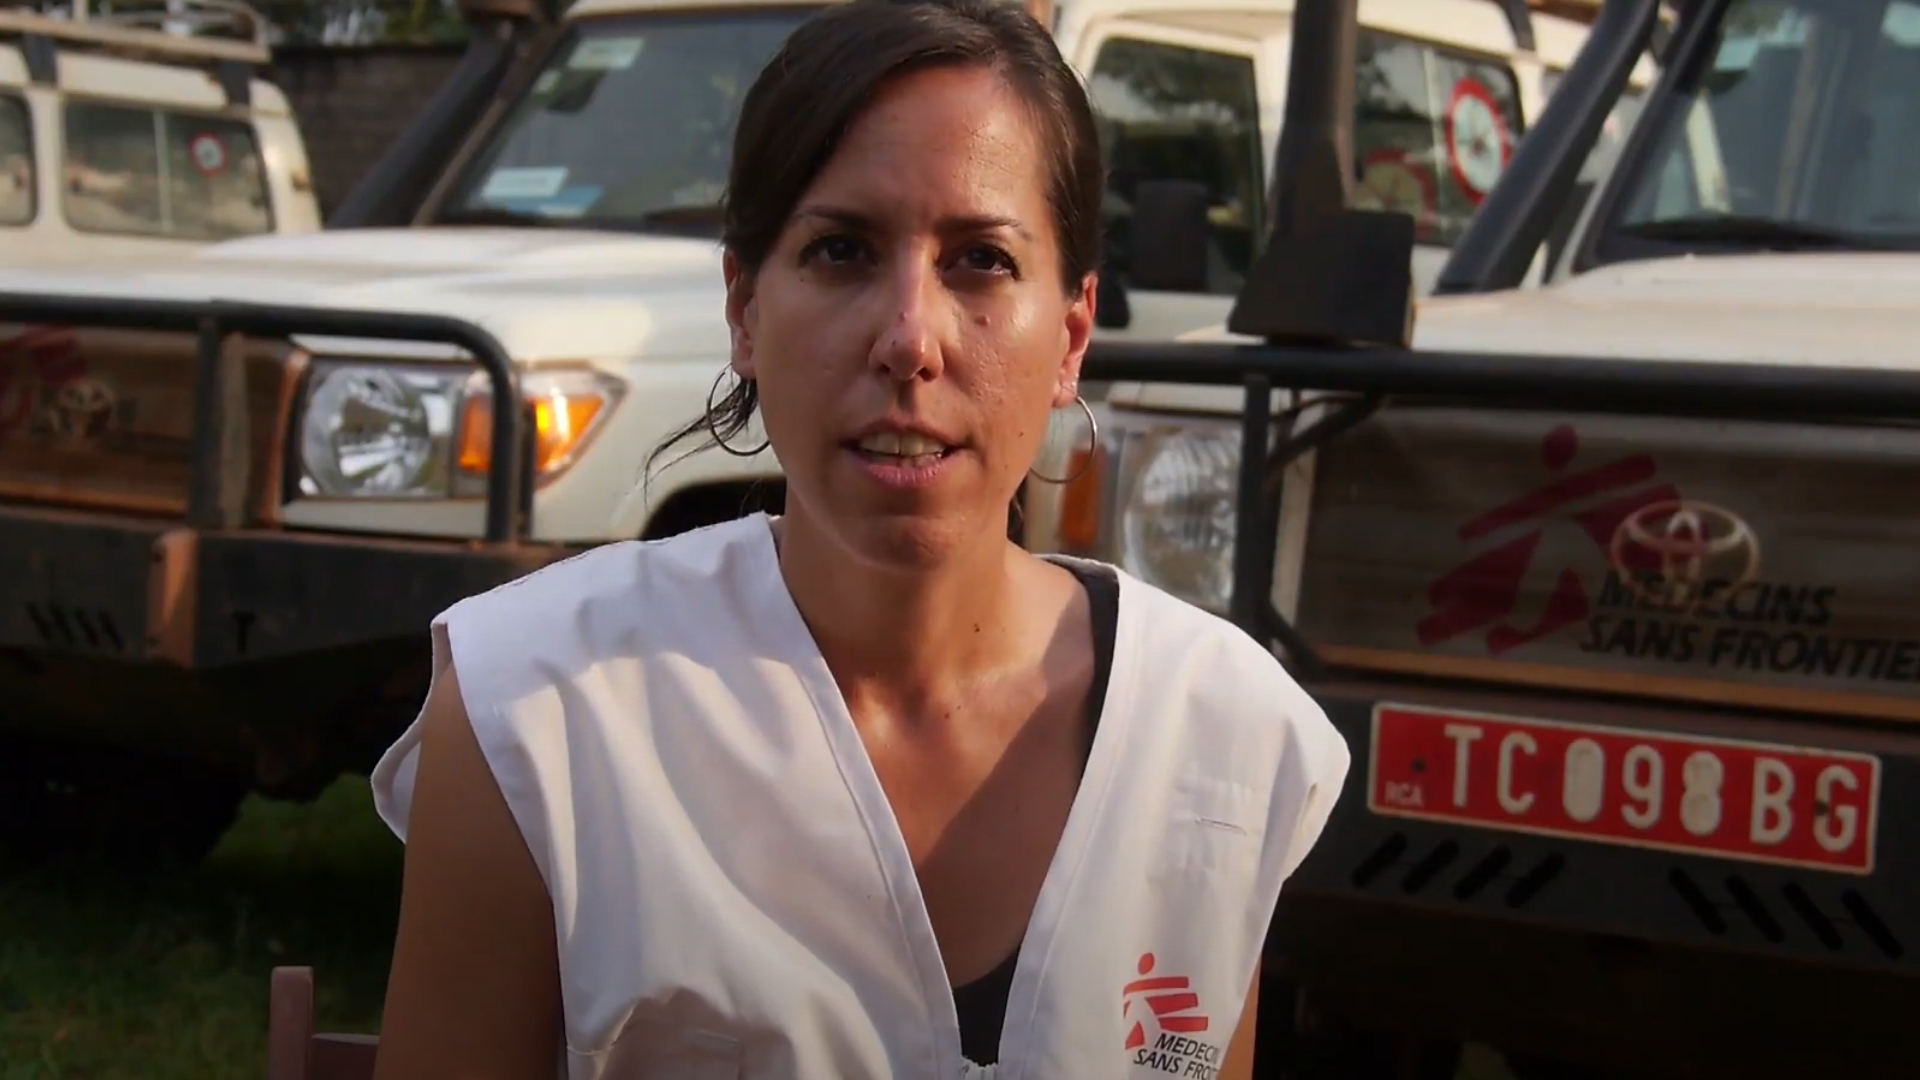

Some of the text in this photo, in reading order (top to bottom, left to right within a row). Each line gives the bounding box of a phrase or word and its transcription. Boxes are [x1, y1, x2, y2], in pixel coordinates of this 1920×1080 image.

[1581, 613, 1920, 683] SANS FRONTIE
[1133, 1048, 1219, 1080] SANS FRO
